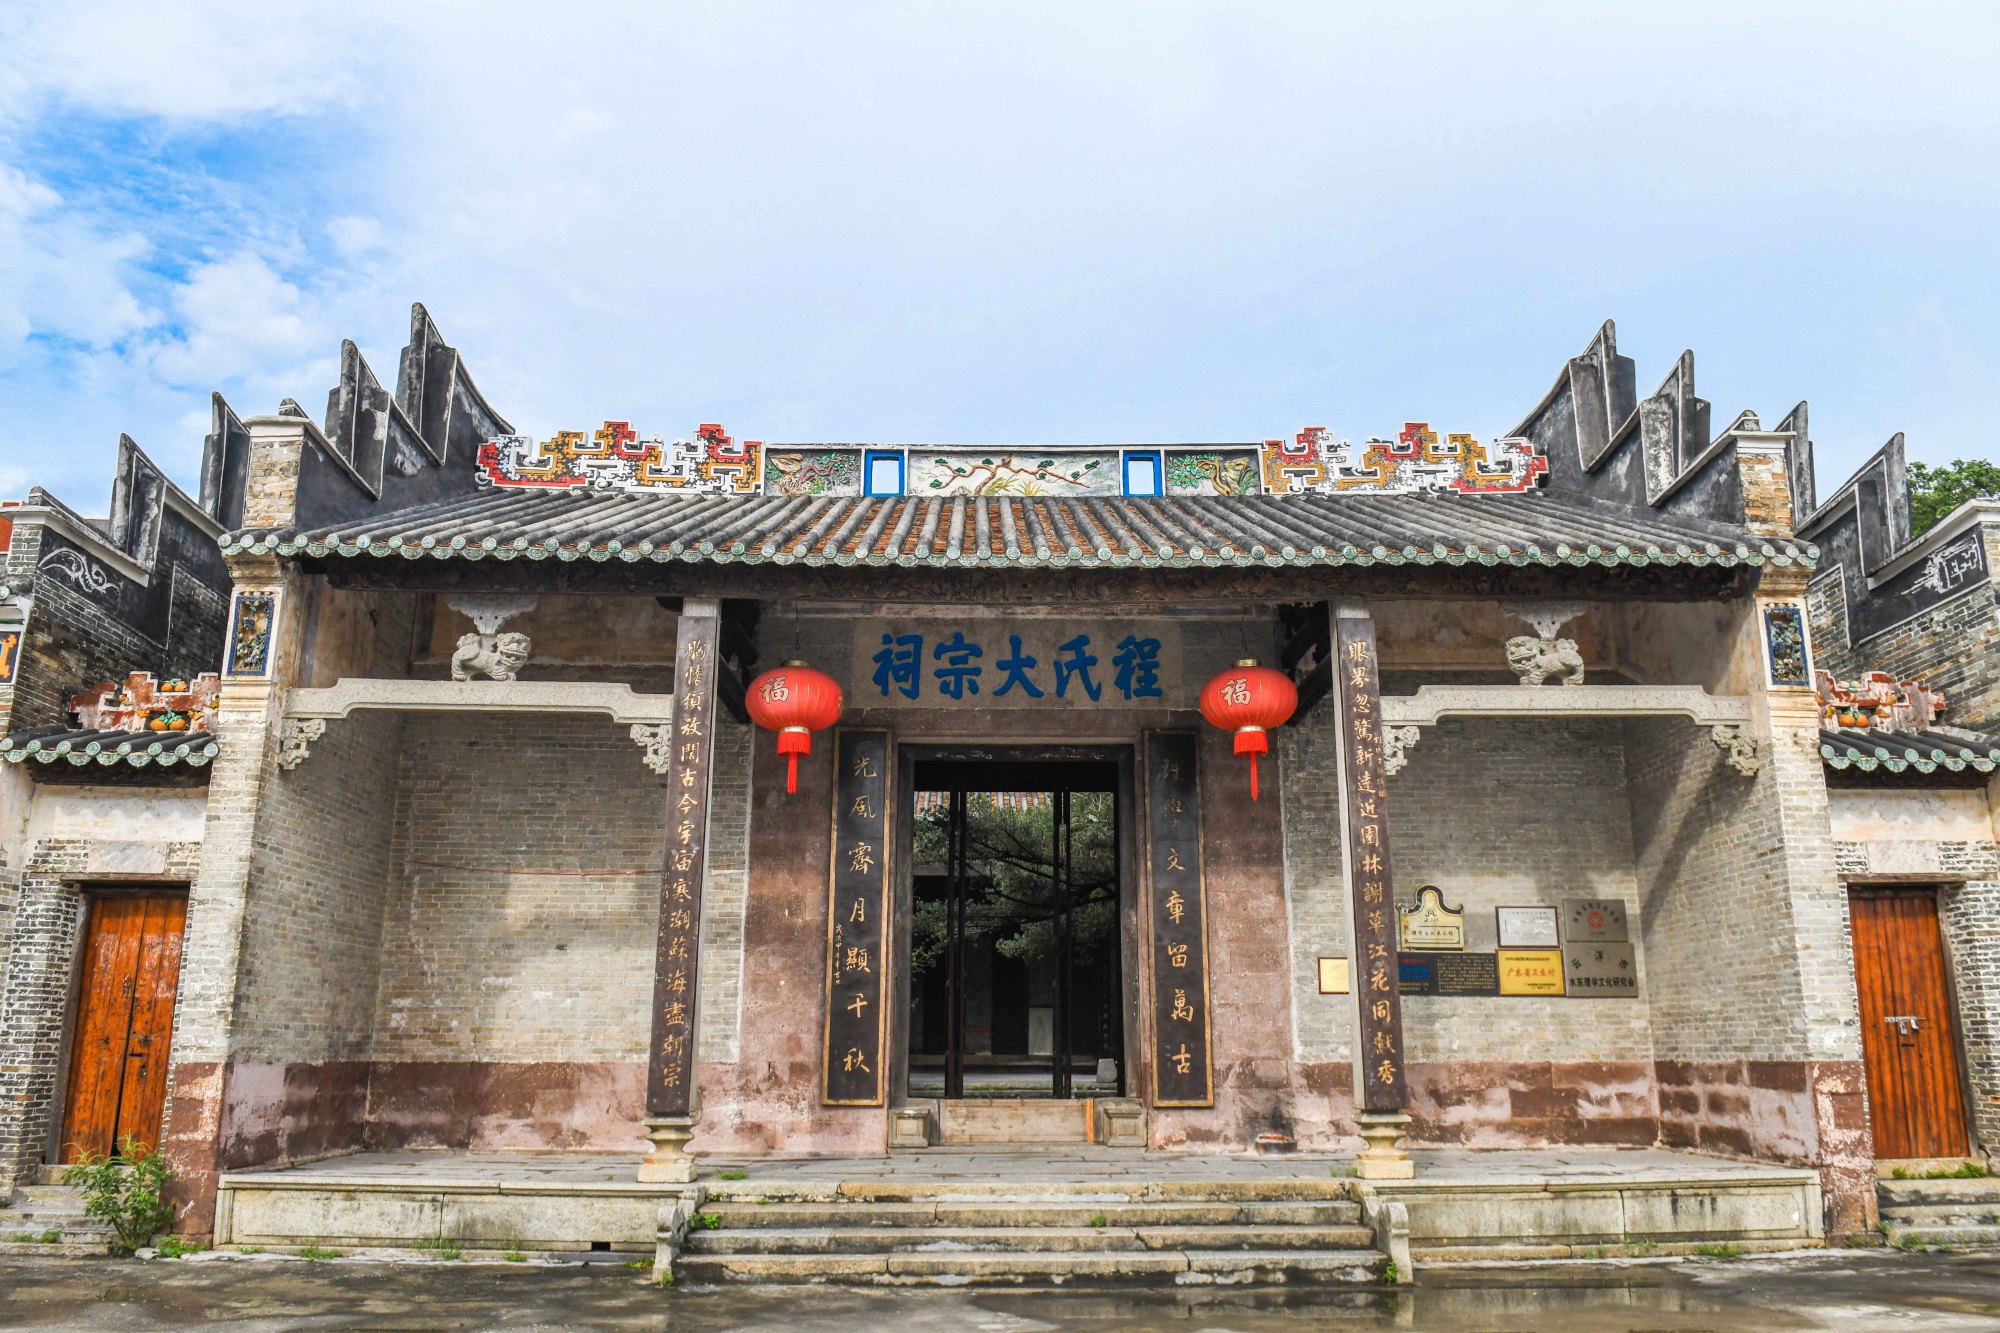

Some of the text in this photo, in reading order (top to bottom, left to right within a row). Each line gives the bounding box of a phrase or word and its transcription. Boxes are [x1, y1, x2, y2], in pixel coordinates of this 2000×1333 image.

[871, 631, 1164, 702] 程氏大宗祠
[759, 676, 789, 704] 福
[1220, 678, 1252, 707] 福
